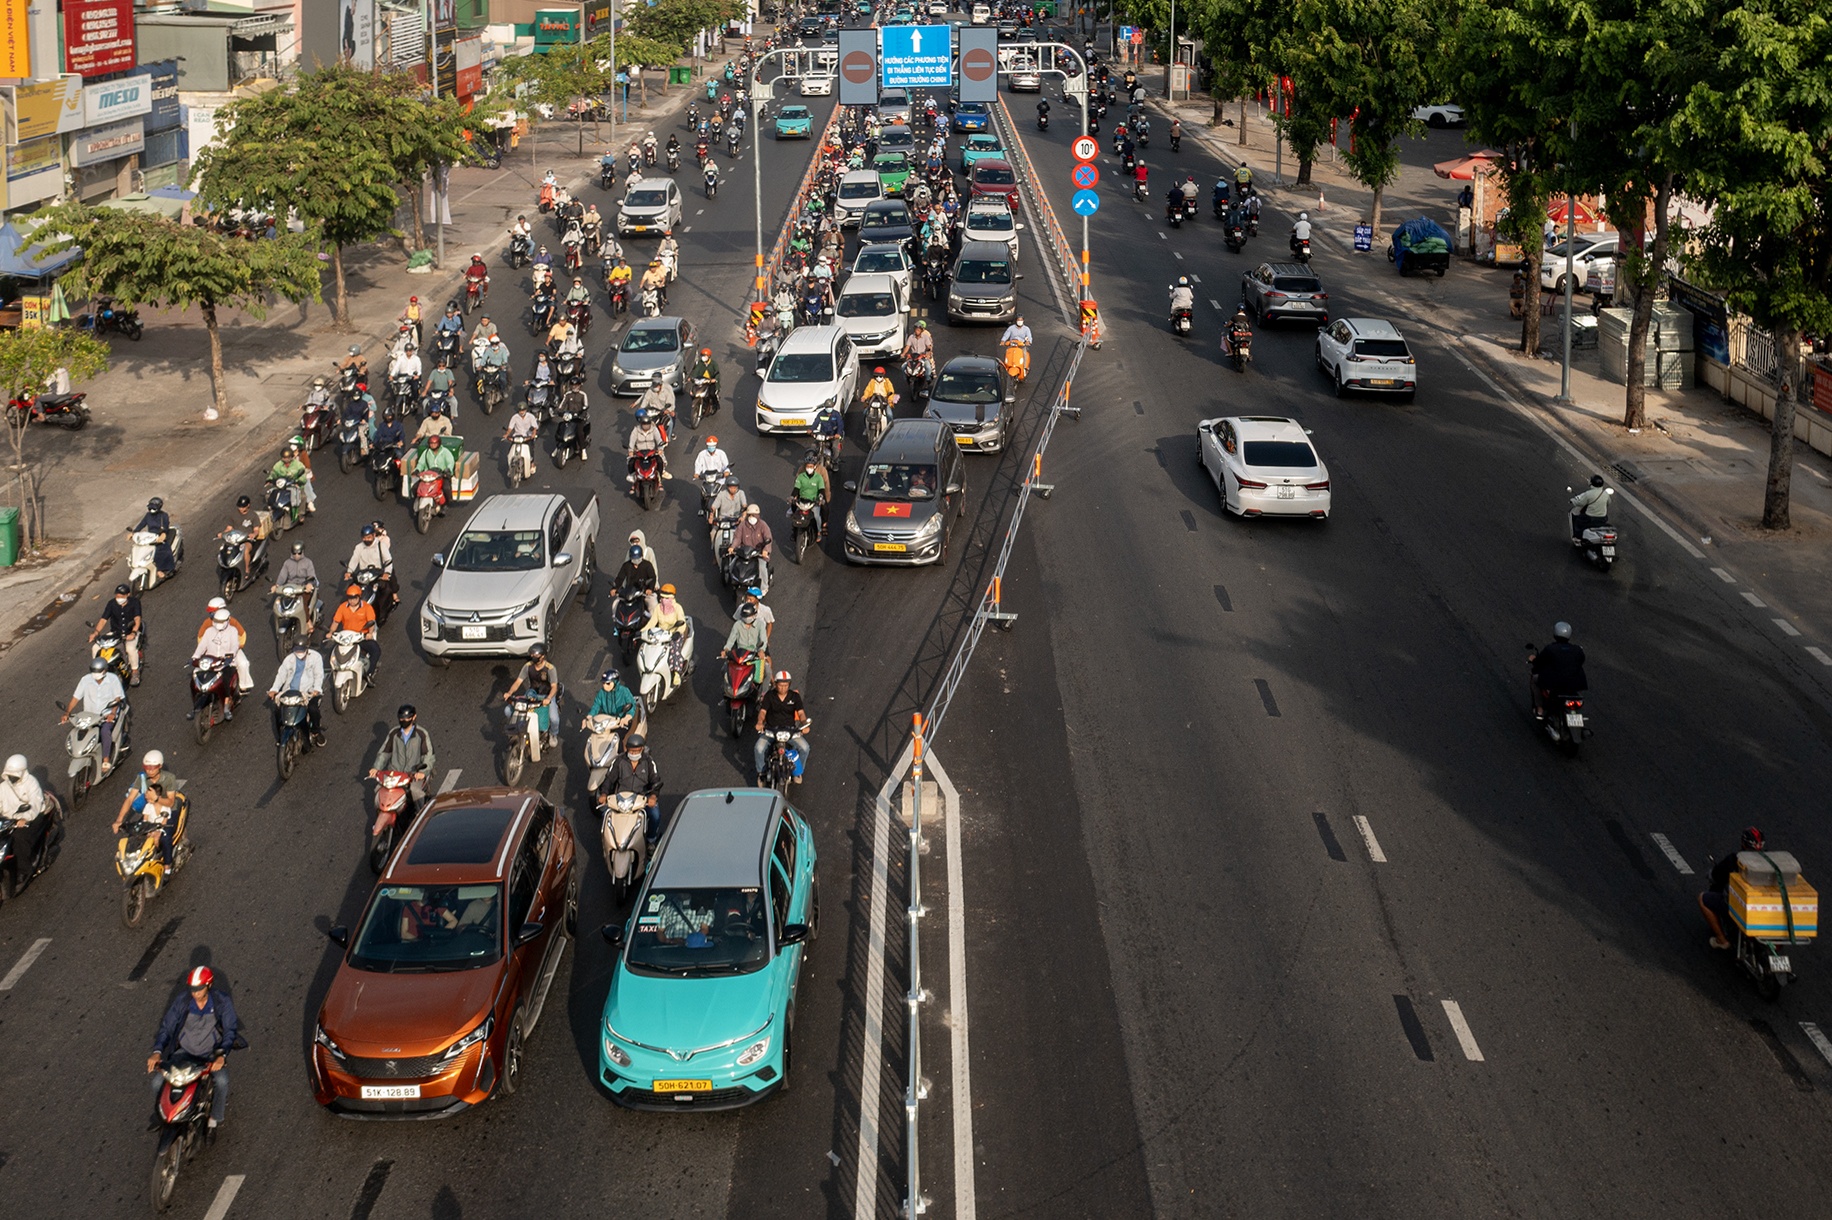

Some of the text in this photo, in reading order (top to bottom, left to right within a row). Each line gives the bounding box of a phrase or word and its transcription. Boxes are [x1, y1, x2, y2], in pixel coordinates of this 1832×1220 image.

[904, 56, 914, 64] CÁC
[937, 55, 949, 64] TIỆN
[925, 66, 935, 74] TỤC
[658, 1081, 707, 1090] 50H-621.07
[366, 1088, 416, 1097] 51K-128.89
